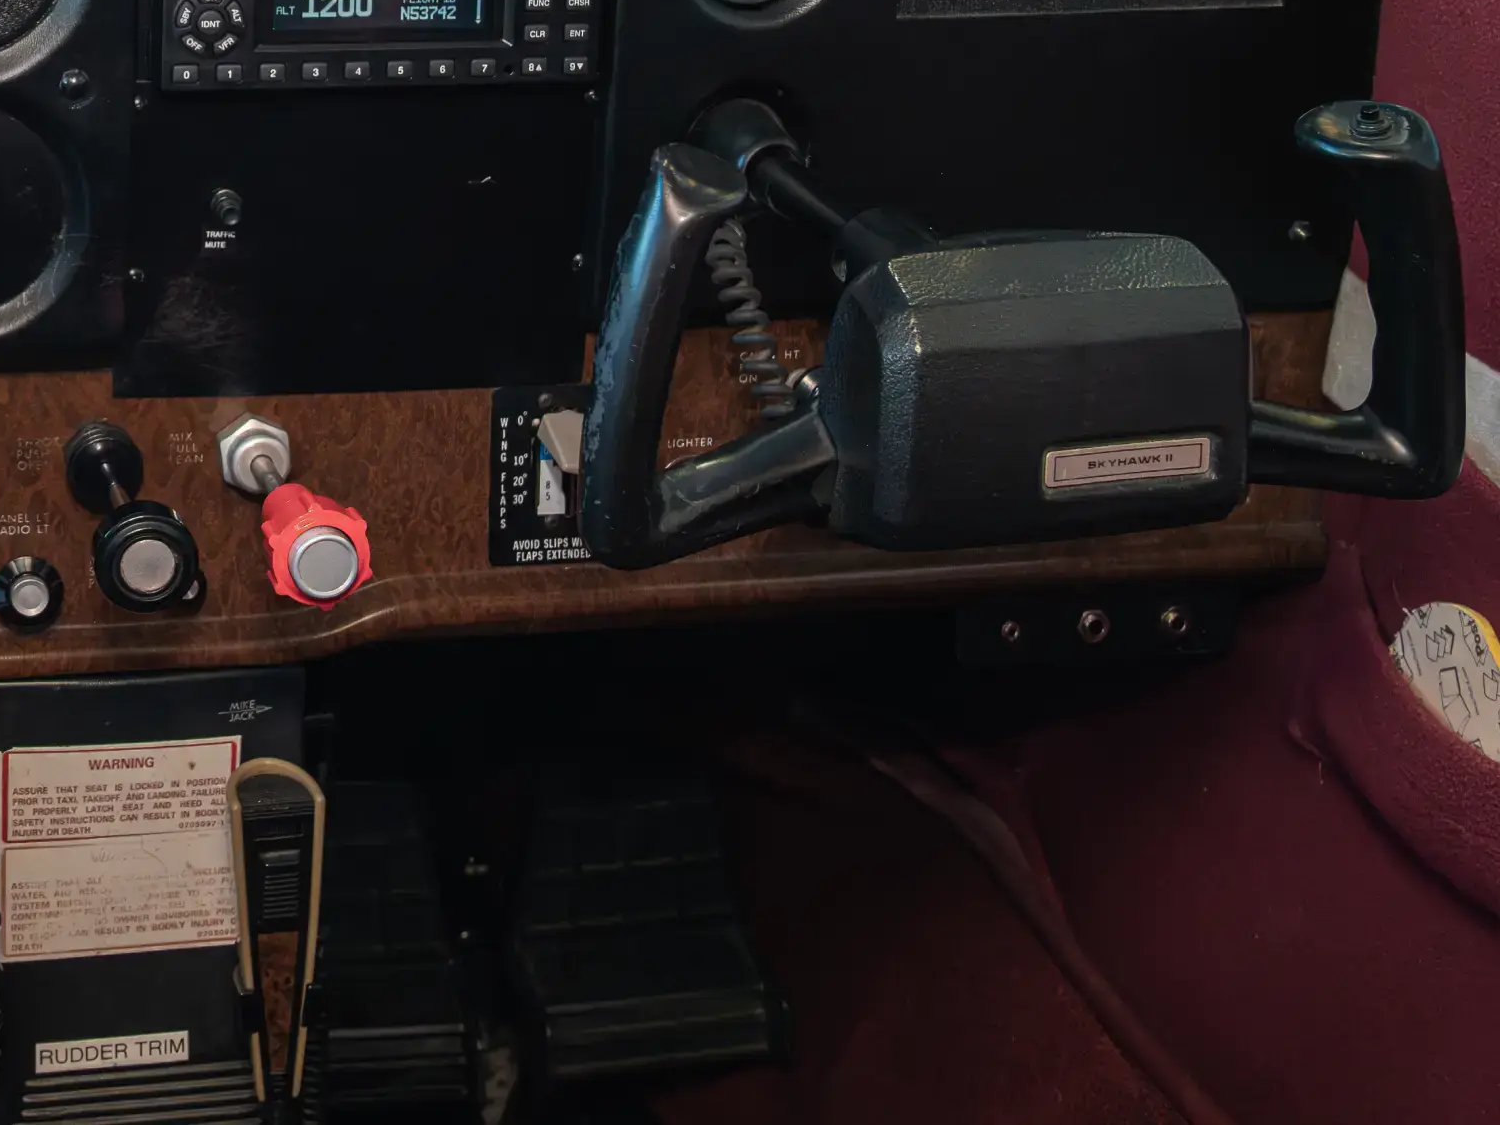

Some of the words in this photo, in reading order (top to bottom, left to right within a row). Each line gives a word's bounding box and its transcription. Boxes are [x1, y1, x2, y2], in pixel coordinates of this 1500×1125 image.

[276, 6, 295, 15] ALT
[528, 0, 550, 7] FUNC
[400, 6, 456, 21] N53742
[1088, 455, 1161, 469] SKYHAWK
[513, 539, 540, 551] AVOID
[543, 538, 569, 549] SLIPS
[88, 757, 155, 771] WARNING
[39, 1043, 128, 1066] RUDDER
[135, 1039, 186, 1057] TRIM
